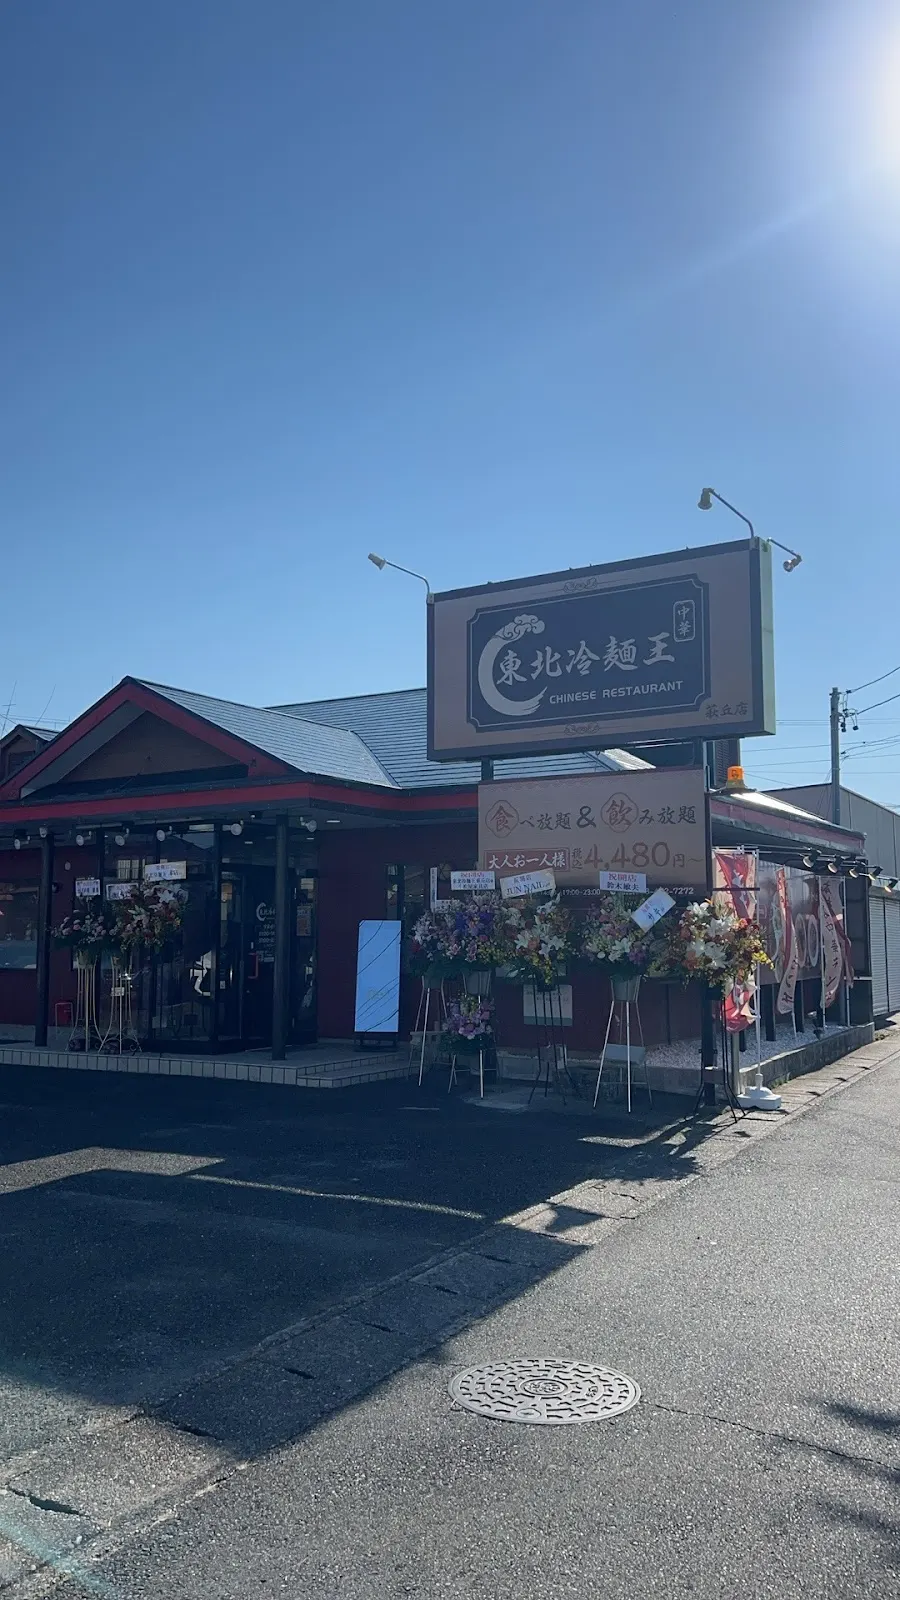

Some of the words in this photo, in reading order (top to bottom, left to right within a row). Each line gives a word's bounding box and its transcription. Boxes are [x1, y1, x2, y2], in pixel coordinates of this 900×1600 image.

[677, 606, 691, 636] 中華
[549, 690, 597, 705] CHINESE
[602, 680, 683, 699] RESTAURANT
[705, 701, 748, 719] 萩丘店
[488, 852, 566, 869] 大人お一人様
